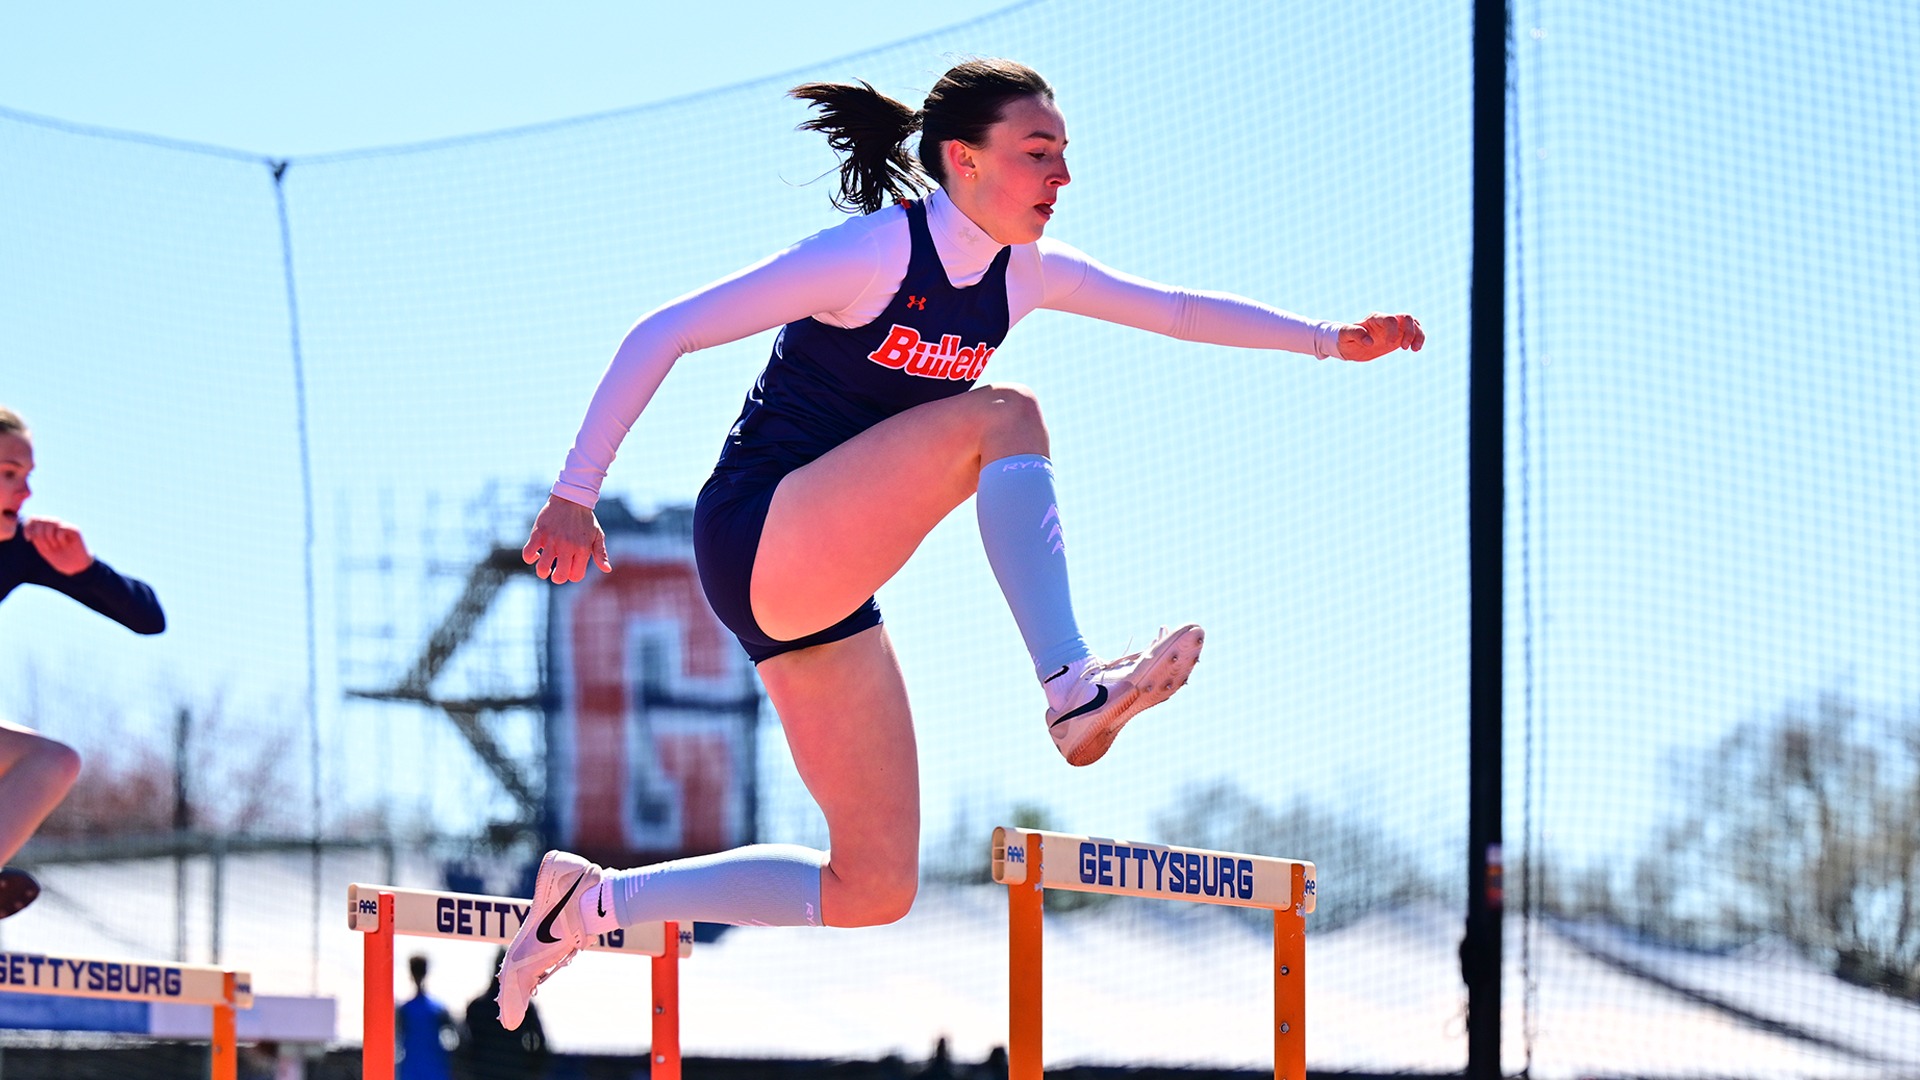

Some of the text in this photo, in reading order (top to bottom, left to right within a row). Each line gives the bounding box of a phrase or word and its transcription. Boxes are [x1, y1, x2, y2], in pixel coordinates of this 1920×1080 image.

[867, 323, 996, 381] Bullets
[561, 545, 738, 855] G
[1079, 841, 1254, 900] GETTYSBURG
